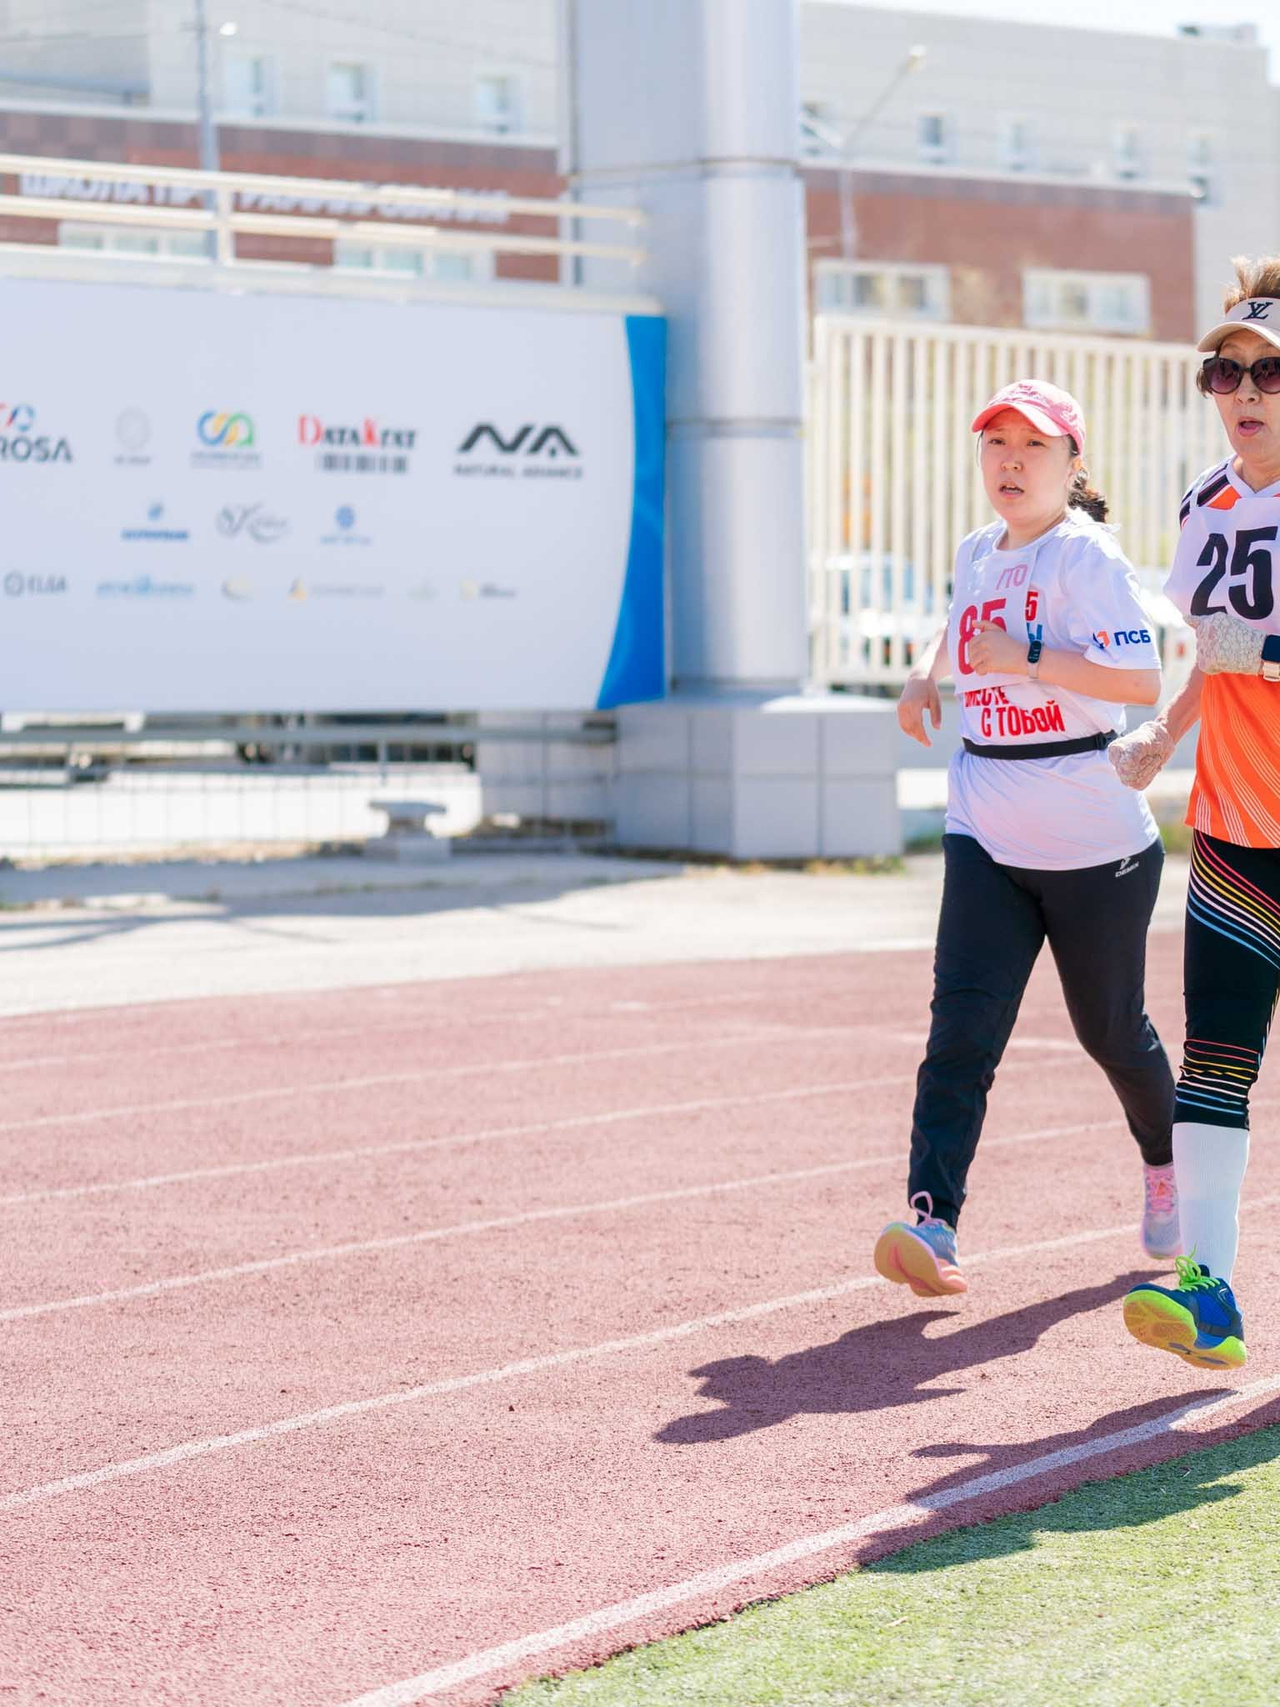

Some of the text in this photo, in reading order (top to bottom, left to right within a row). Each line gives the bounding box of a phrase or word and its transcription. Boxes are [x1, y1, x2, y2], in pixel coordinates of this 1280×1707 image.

[1190, 526, 1278, 620] 25
[1114, 629, 1151, 646] ПСБ
[981, 700, 1065, 737] С ТОБОЙ
